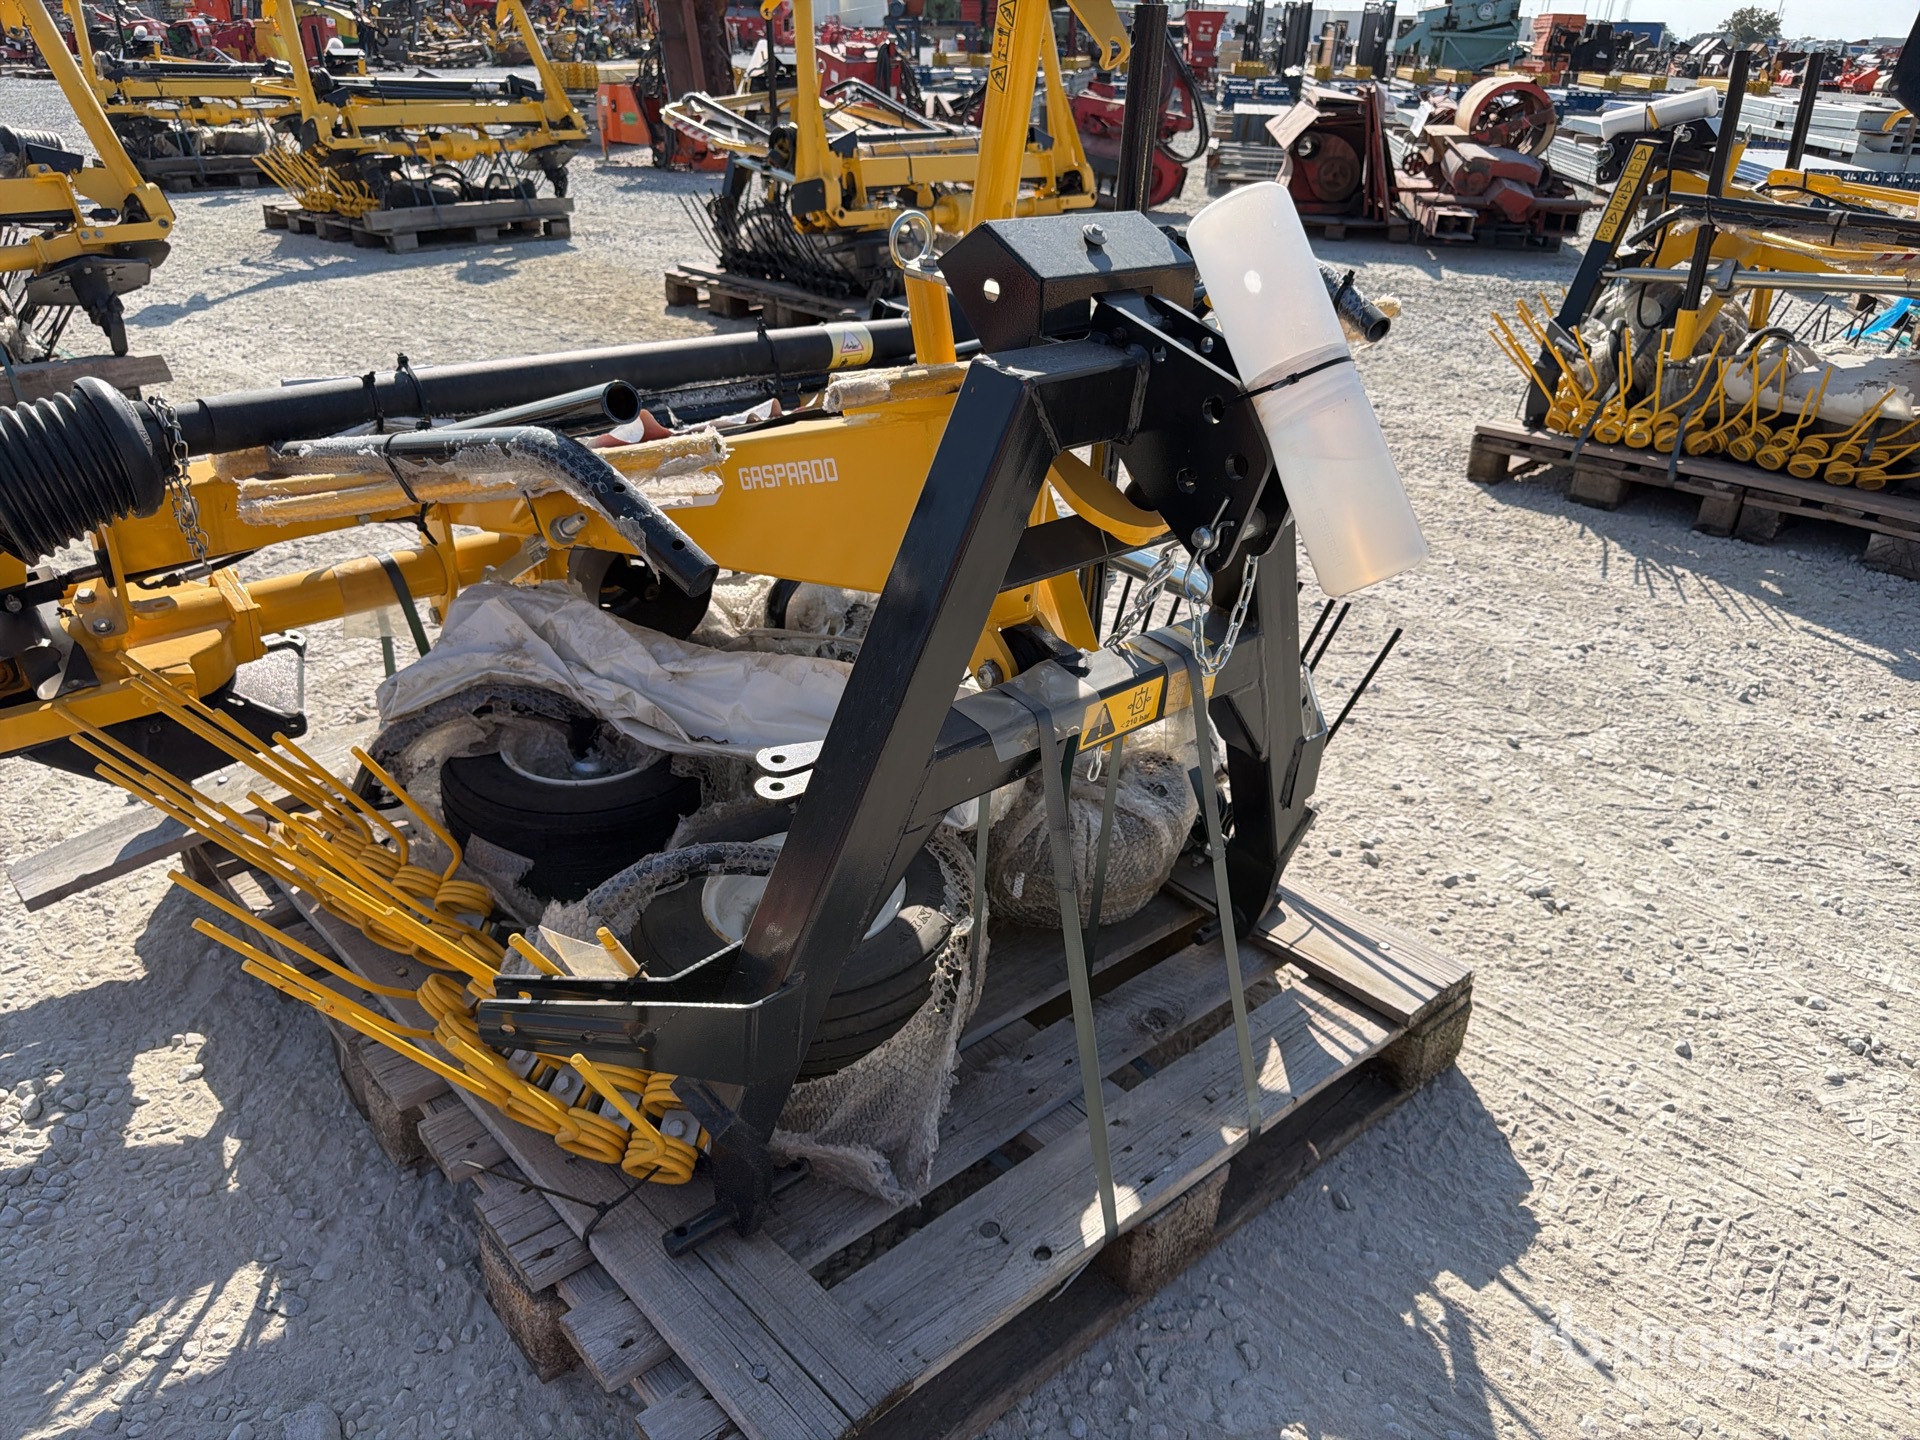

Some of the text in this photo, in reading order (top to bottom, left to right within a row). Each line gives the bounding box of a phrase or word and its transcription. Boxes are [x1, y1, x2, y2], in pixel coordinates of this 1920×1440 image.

[738, 458, 838, 490] GASPARDO
[1121, 713, 1150, 728] <210 bar
